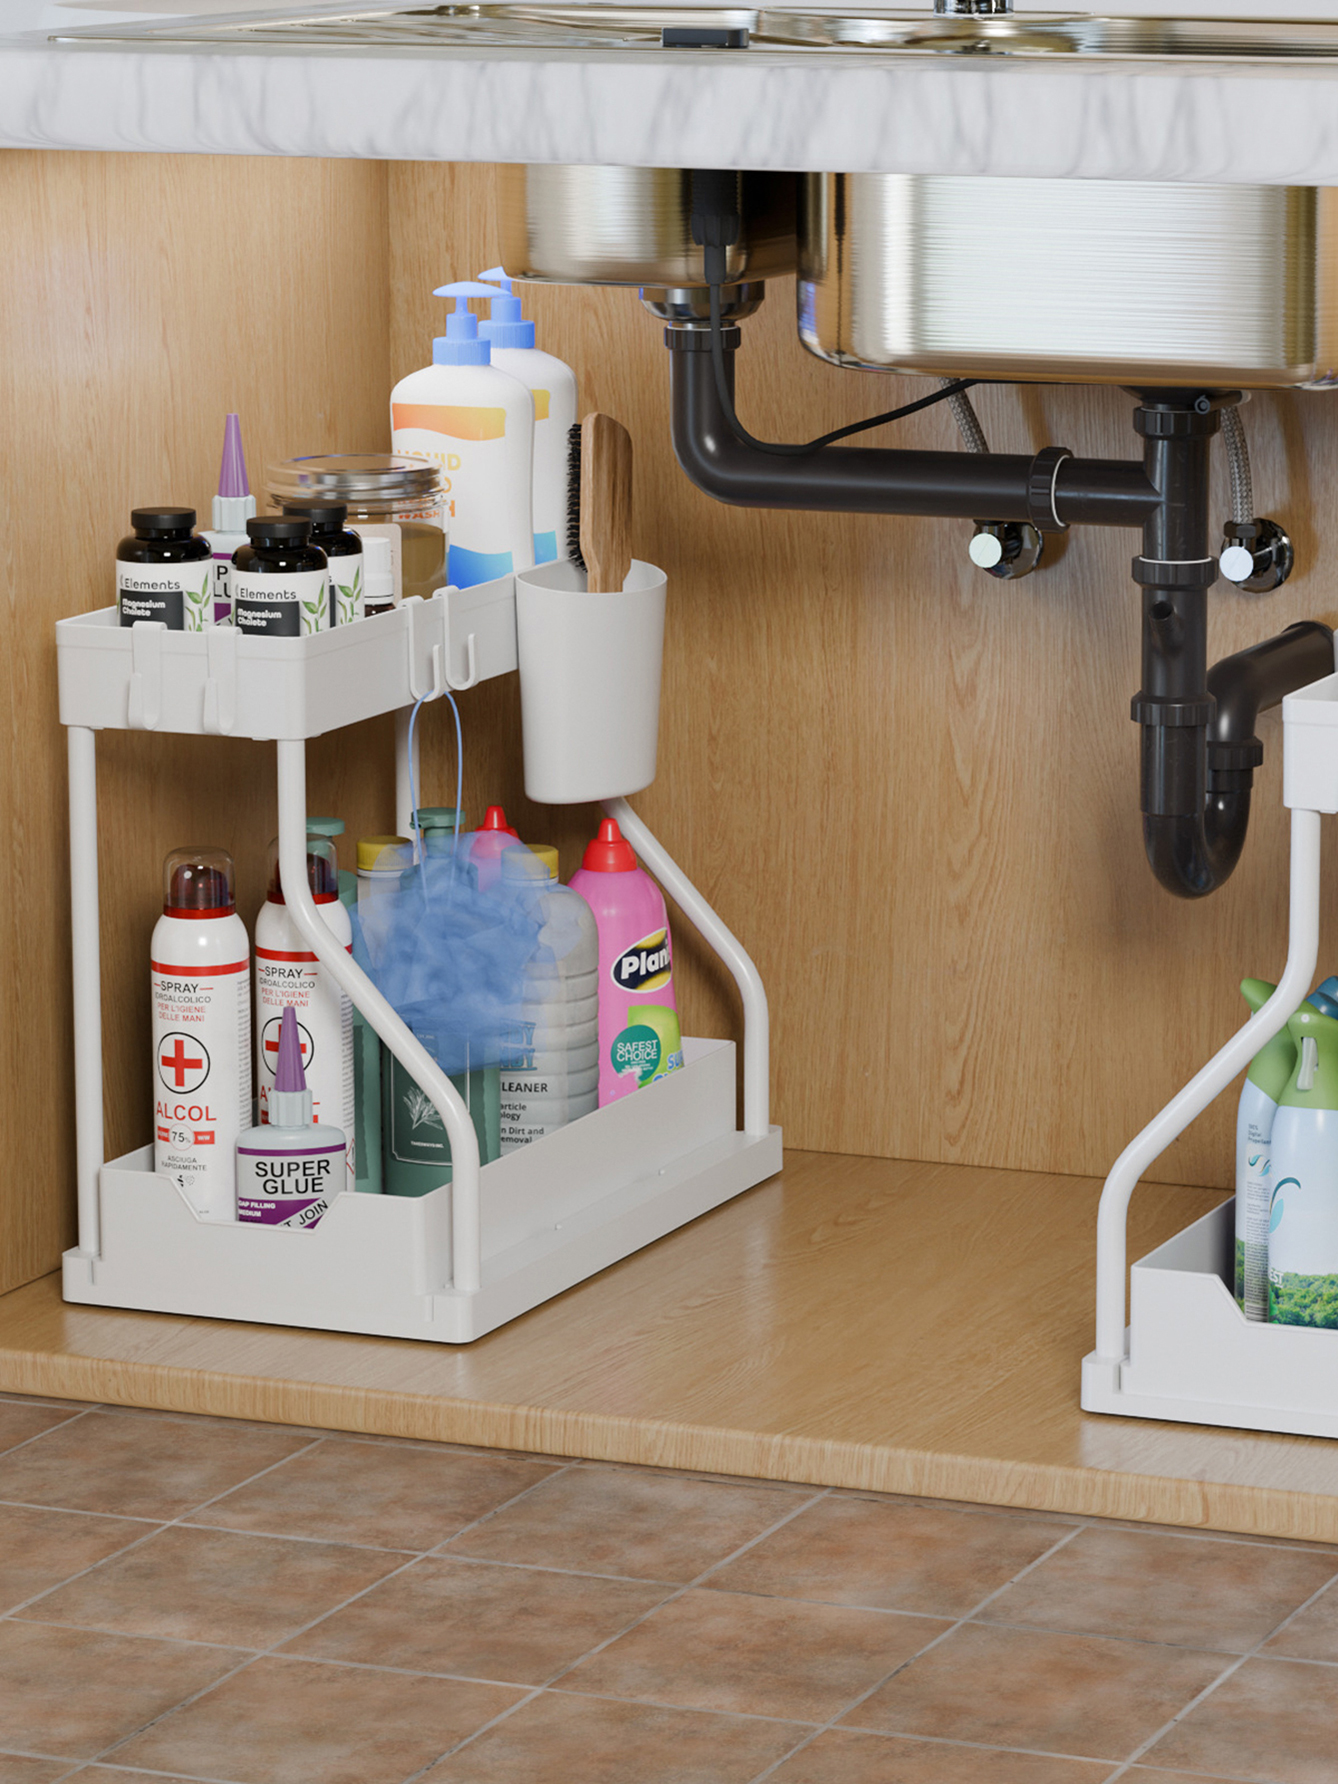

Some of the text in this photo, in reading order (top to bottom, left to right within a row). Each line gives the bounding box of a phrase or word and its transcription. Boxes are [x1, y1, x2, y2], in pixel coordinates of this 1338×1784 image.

[125, 577, 180, 591] Elements
[240, 587, 297, 600] Elements
[265, 966, 303, 979] SPRAY
[161, 981, 199, 994] SPRAY
[262, 996, 284, 1006] DELLE
[182, 1014, 205, 1022] MANI
[616, 1039, 658, 1052] SAFEST
[616, 1049, 658, 1062] CHOICE
[501, 1081, 548, 1093] LEANER
[156, 1101, 217, 1121] ALCOL
[500, 1102, 527, 1112] article
[508, 1126, 525, 1136] Dirt
[527, 1126, 544, 1136] and
[500, 1136, 533, 1144] emoval
[167, 1155, 198, 1165] ASCIUGA
[255, 1159, 331, 1178] SUPER
[262, 1176, 324, 1195] GLUE
[250, 1201, 276, 1210] FILLING
[299, 1200, 329, 1226] JOIN
